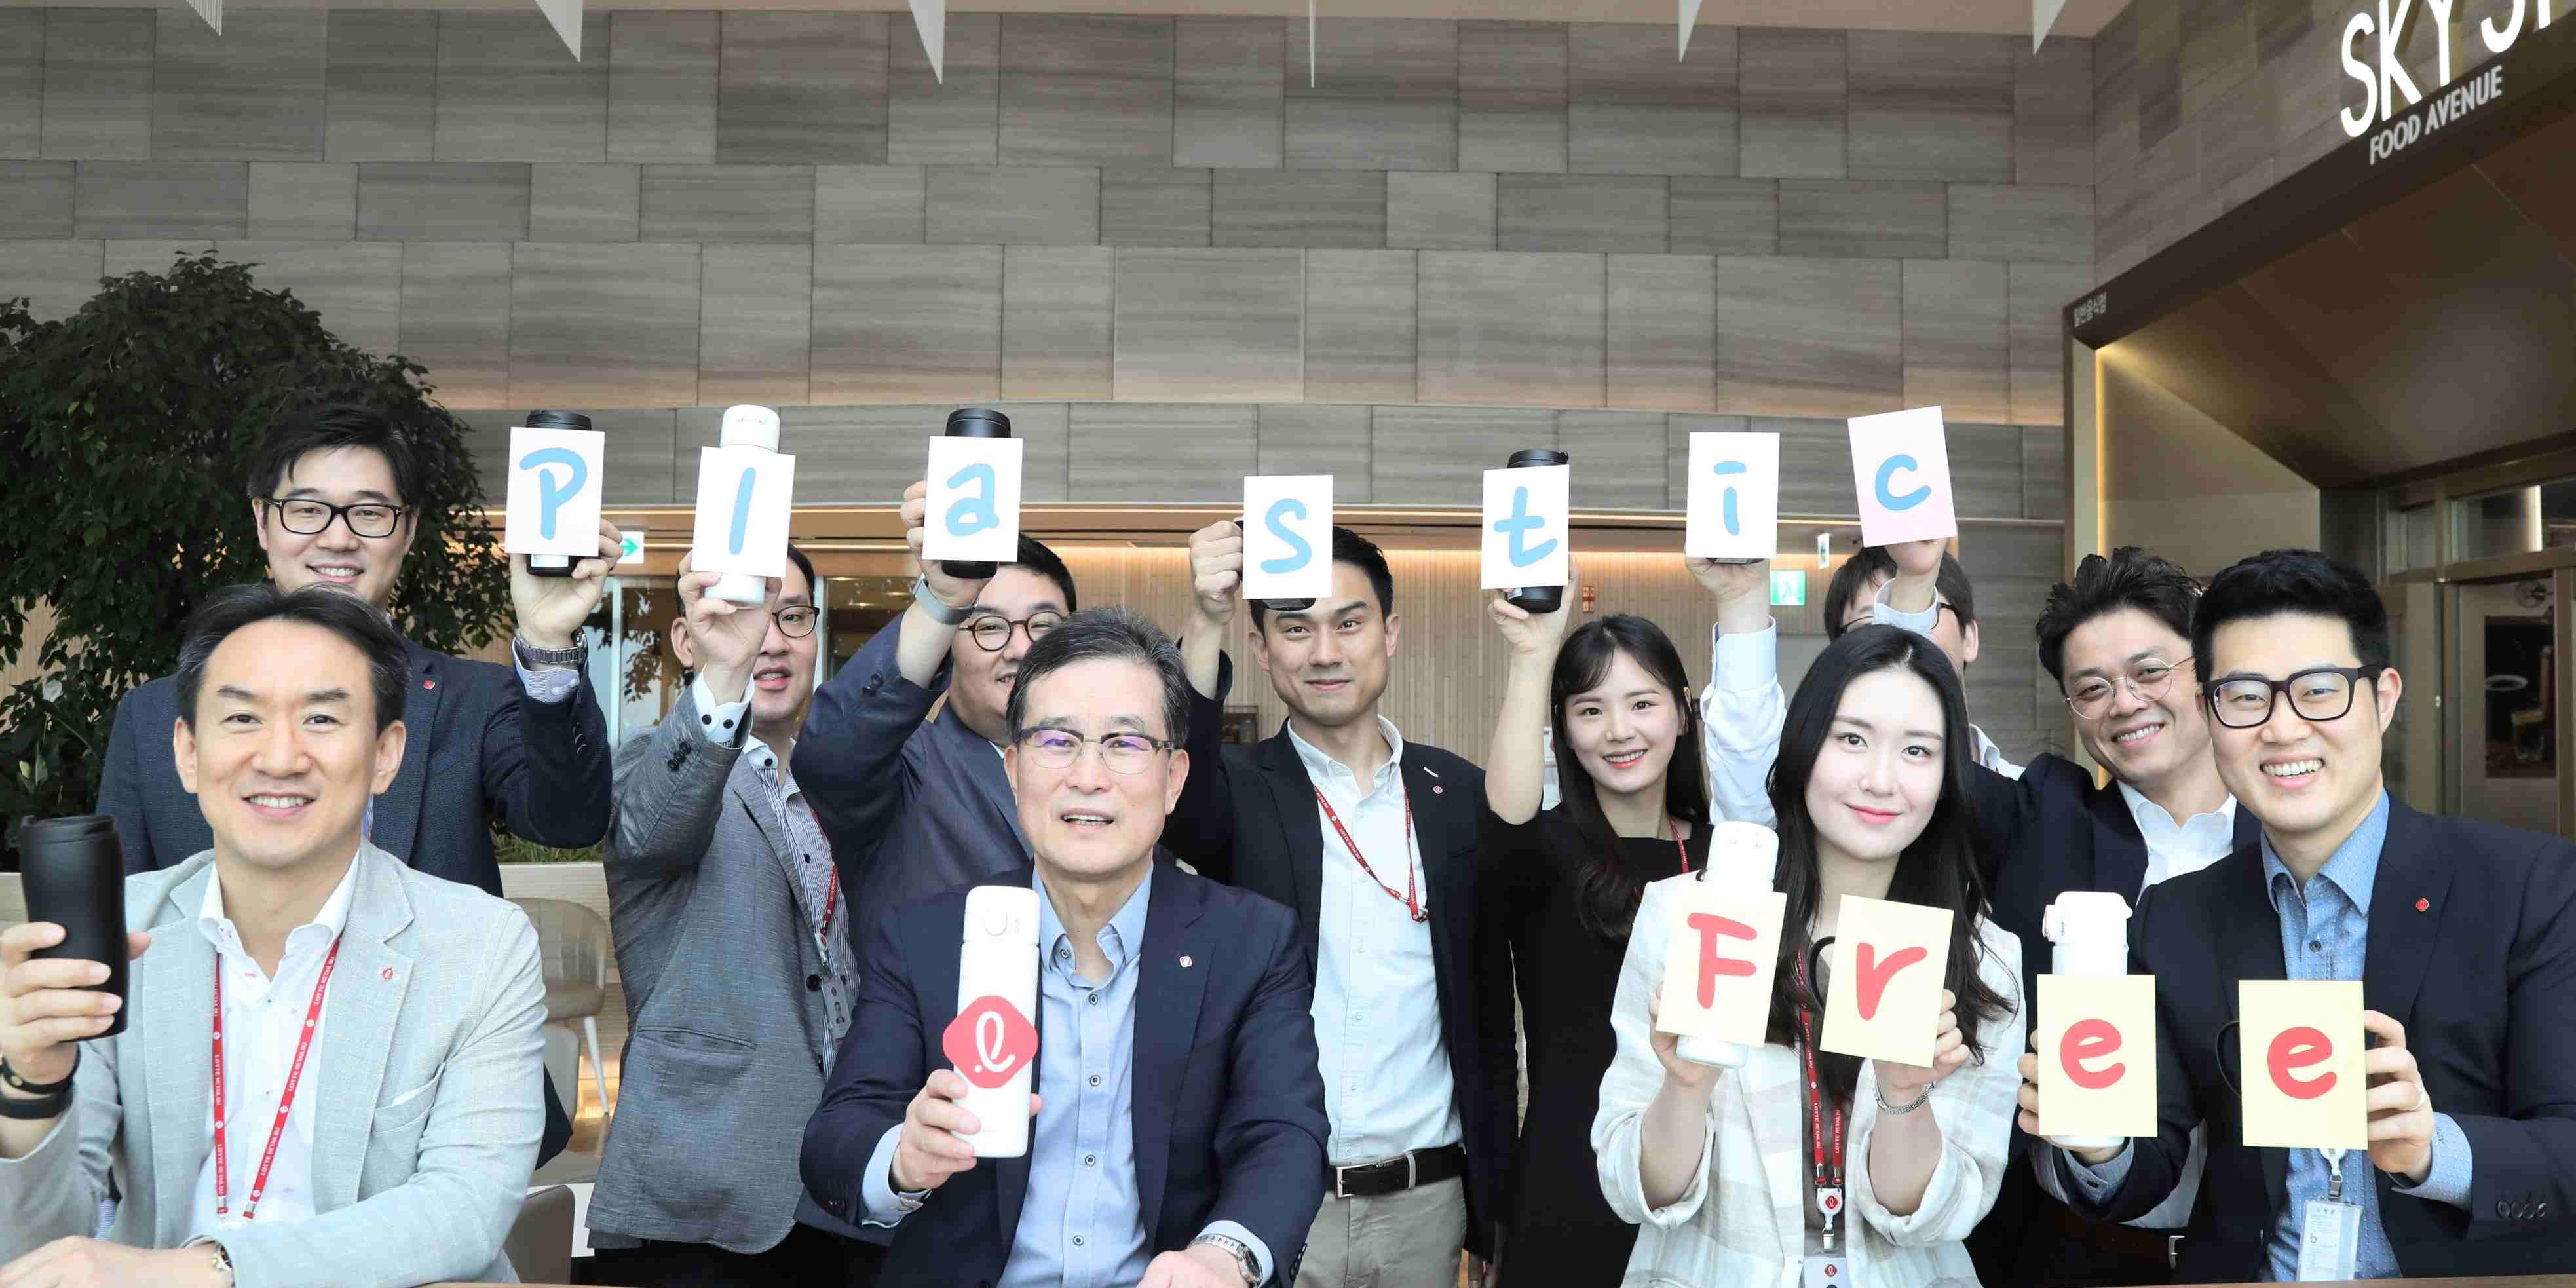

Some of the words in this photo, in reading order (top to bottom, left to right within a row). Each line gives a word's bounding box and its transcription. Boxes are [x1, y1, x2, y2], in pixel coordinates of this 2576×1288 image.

[2341, 0, 2453, 138] SKY
[2369, 114, 2421, 166] FOOD
[2424, 65, 2503, 135] AVENUE
[945, 463, 1000, 537] a
[1494, 486, 1557, 567] t
[1714, 461, 1746, 535] i
[313, 983, 325, 1006] LOTTE
[1688, 913, 1756, 1009] F
[287, 1070, 299, 1092] LOTTE
[2060, 1018, 2126, 1089] e
[2267, 1025, 2338, 1101] e
[259, 1155, 271, 1176] LOTTE
